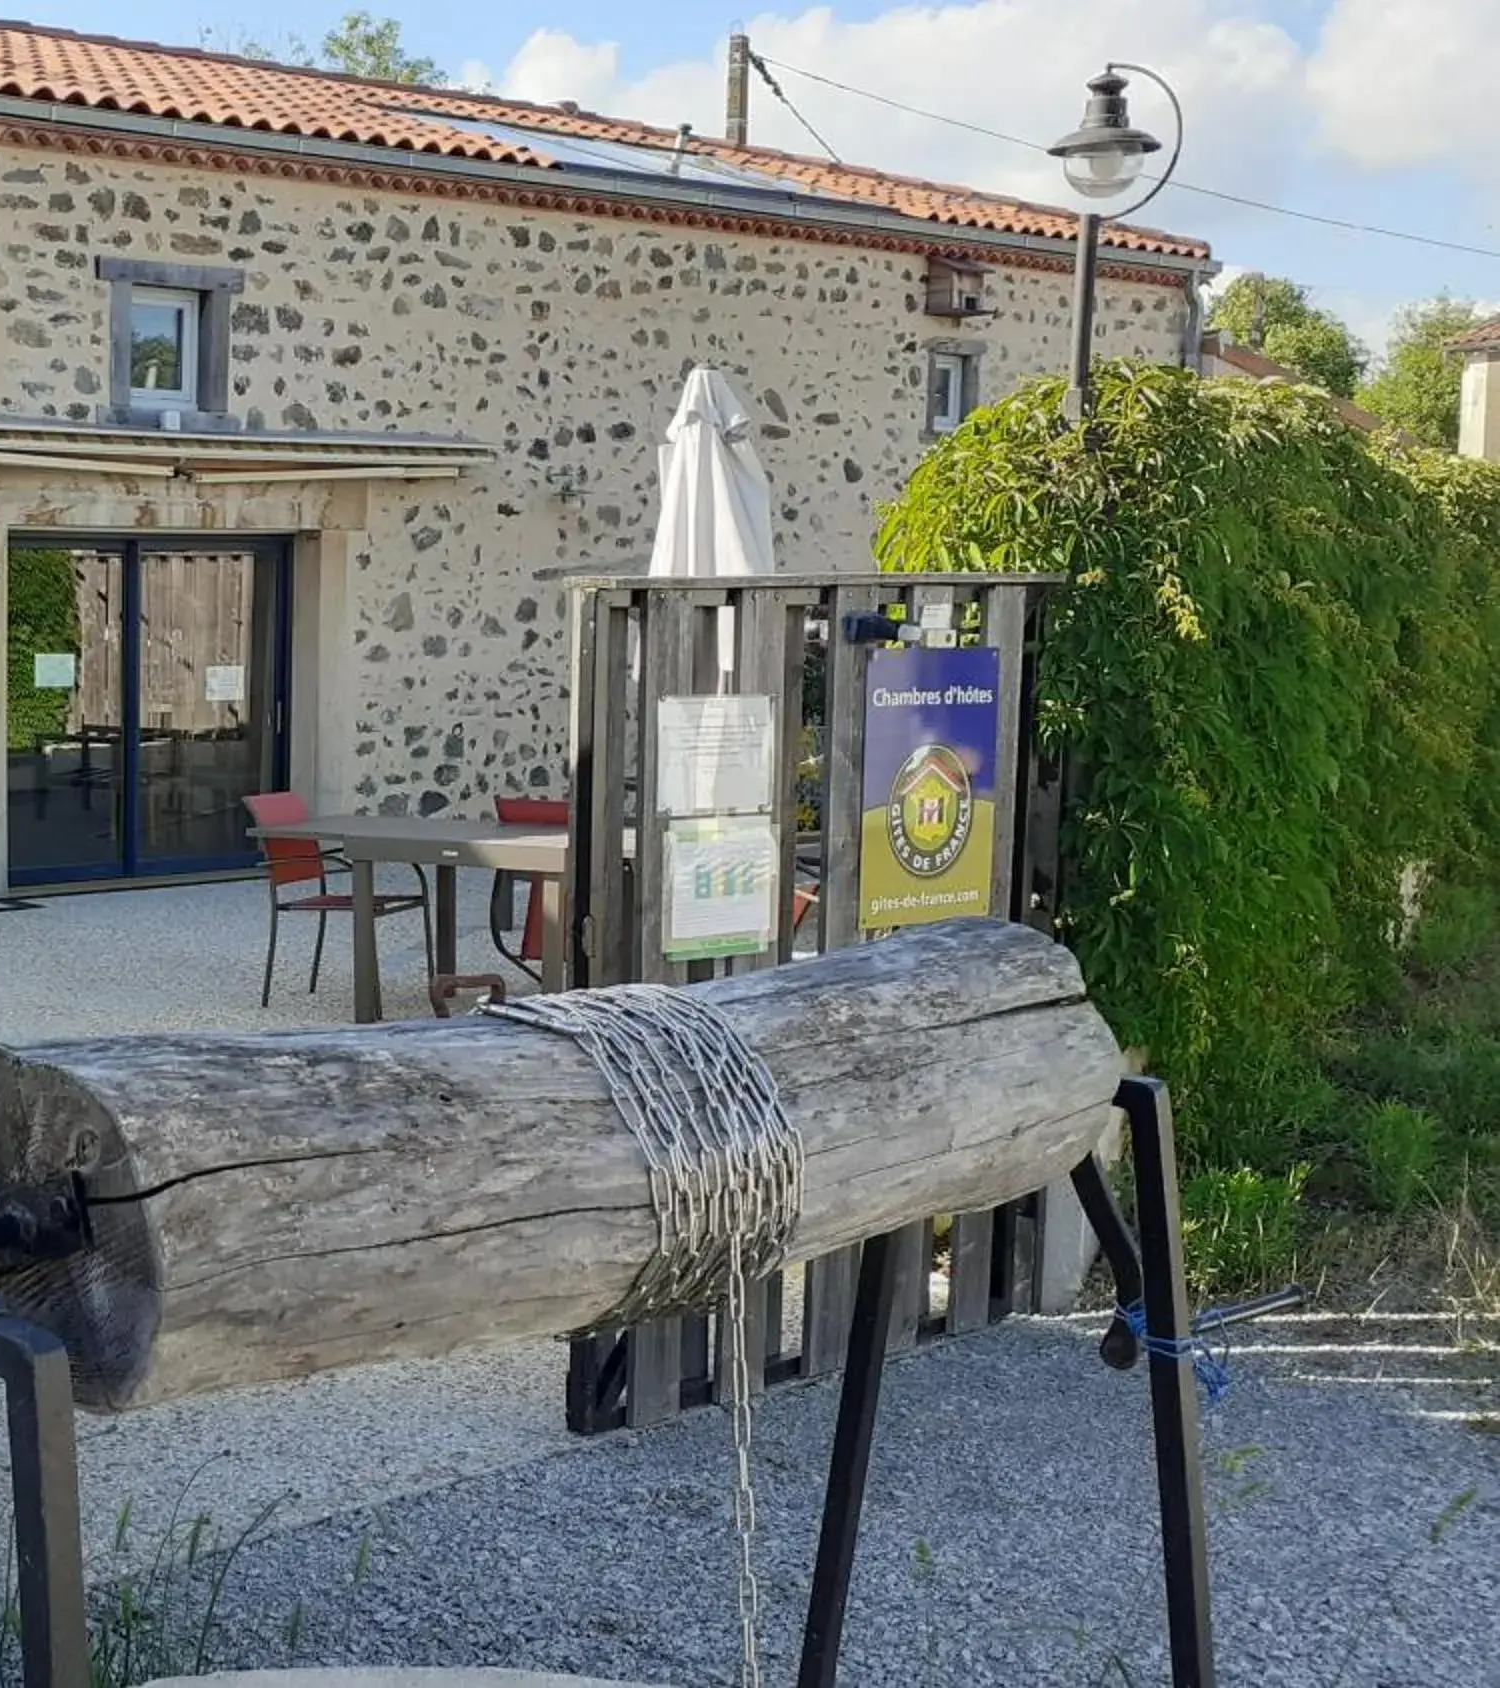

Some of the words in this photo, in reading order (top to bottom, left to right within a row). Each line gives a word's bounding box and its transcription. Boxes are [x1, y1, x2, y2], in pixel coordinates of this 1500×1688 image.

[873, 687, 941, 706] Chambres
[944, 685, 993, 705] d'hôtes
[912, 853, 931, 871] DE
[935, 799, 969, 867] FRANCE
